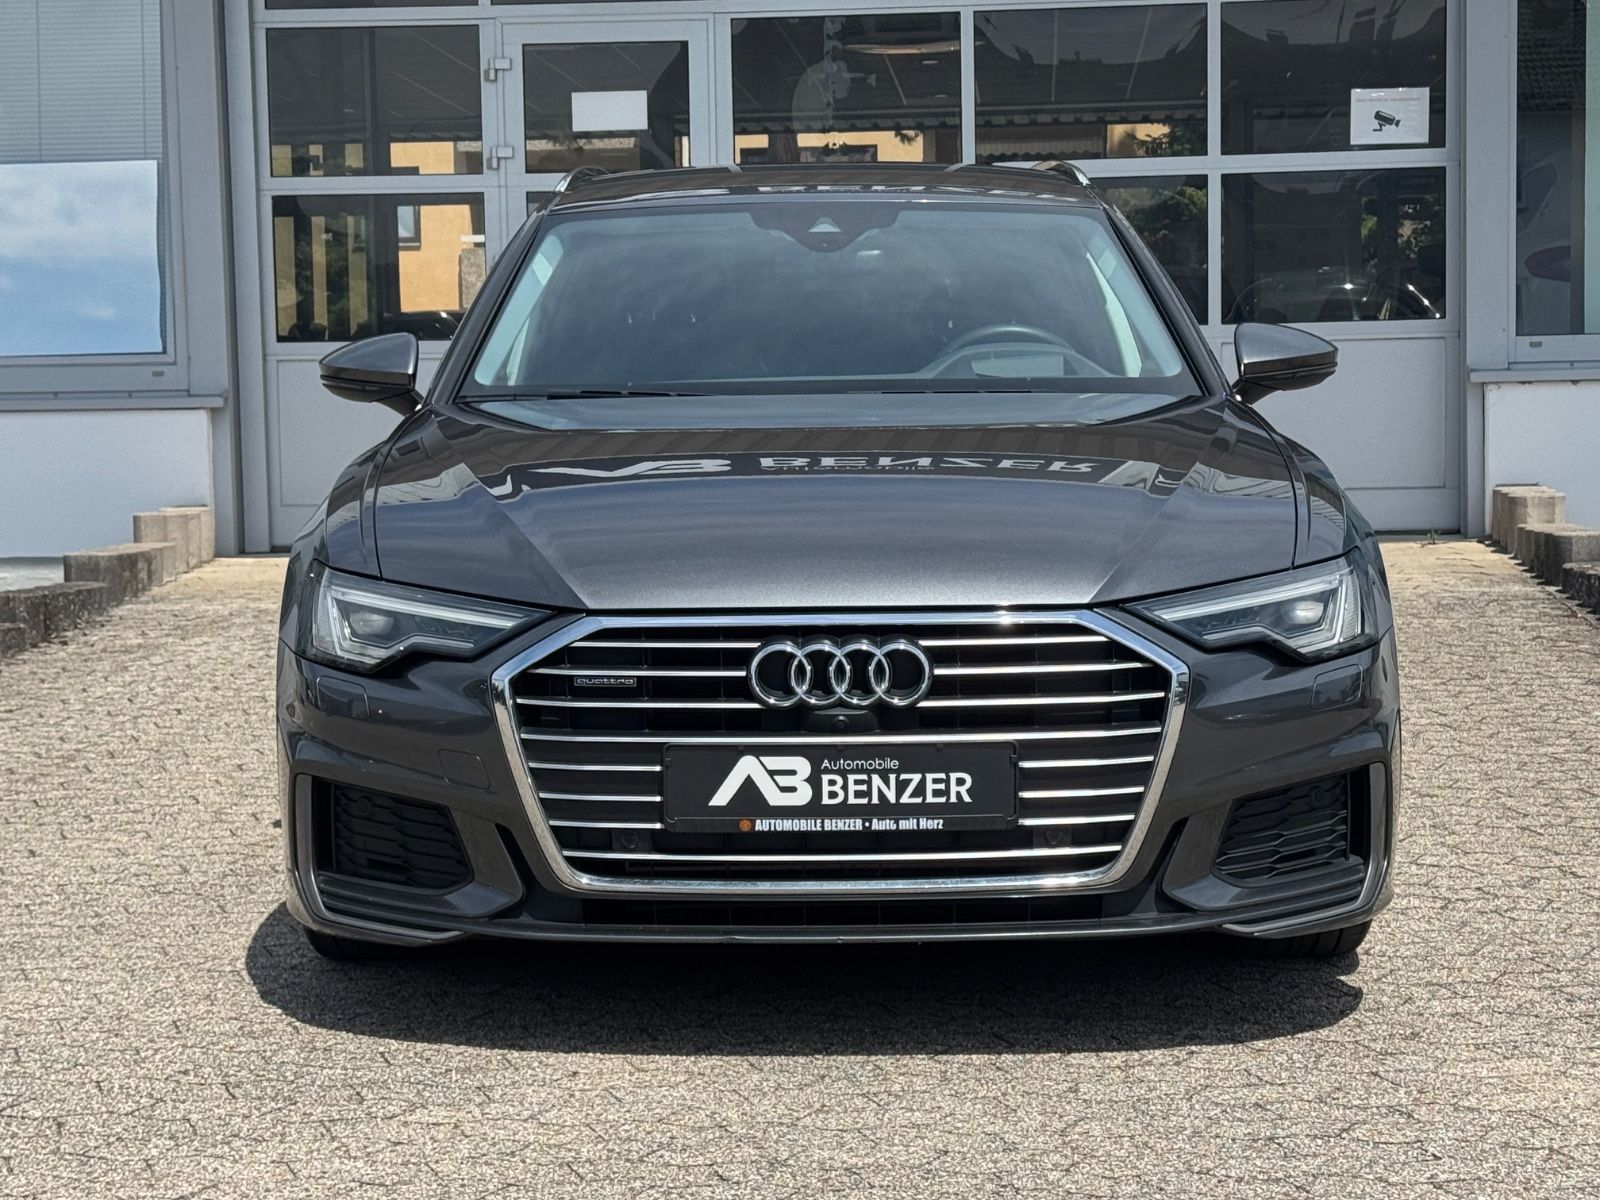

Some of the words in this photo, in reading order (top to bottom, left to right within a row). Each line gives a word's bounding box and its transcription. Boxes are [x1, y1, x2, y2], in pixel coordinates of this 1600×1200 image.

[577, 678, 634, 686] quattro
[821, 757, 900, 770] Automobile
[708, 755, 813, 807] AB
[821, 772, 973, 805] BENZER
[754, 819, 822, 831] AUTOMOBILE
[823, 819, 863, 831] BENZER
[898, 817, 918, 830] mit
[919, 817, 944, 830] Herz
